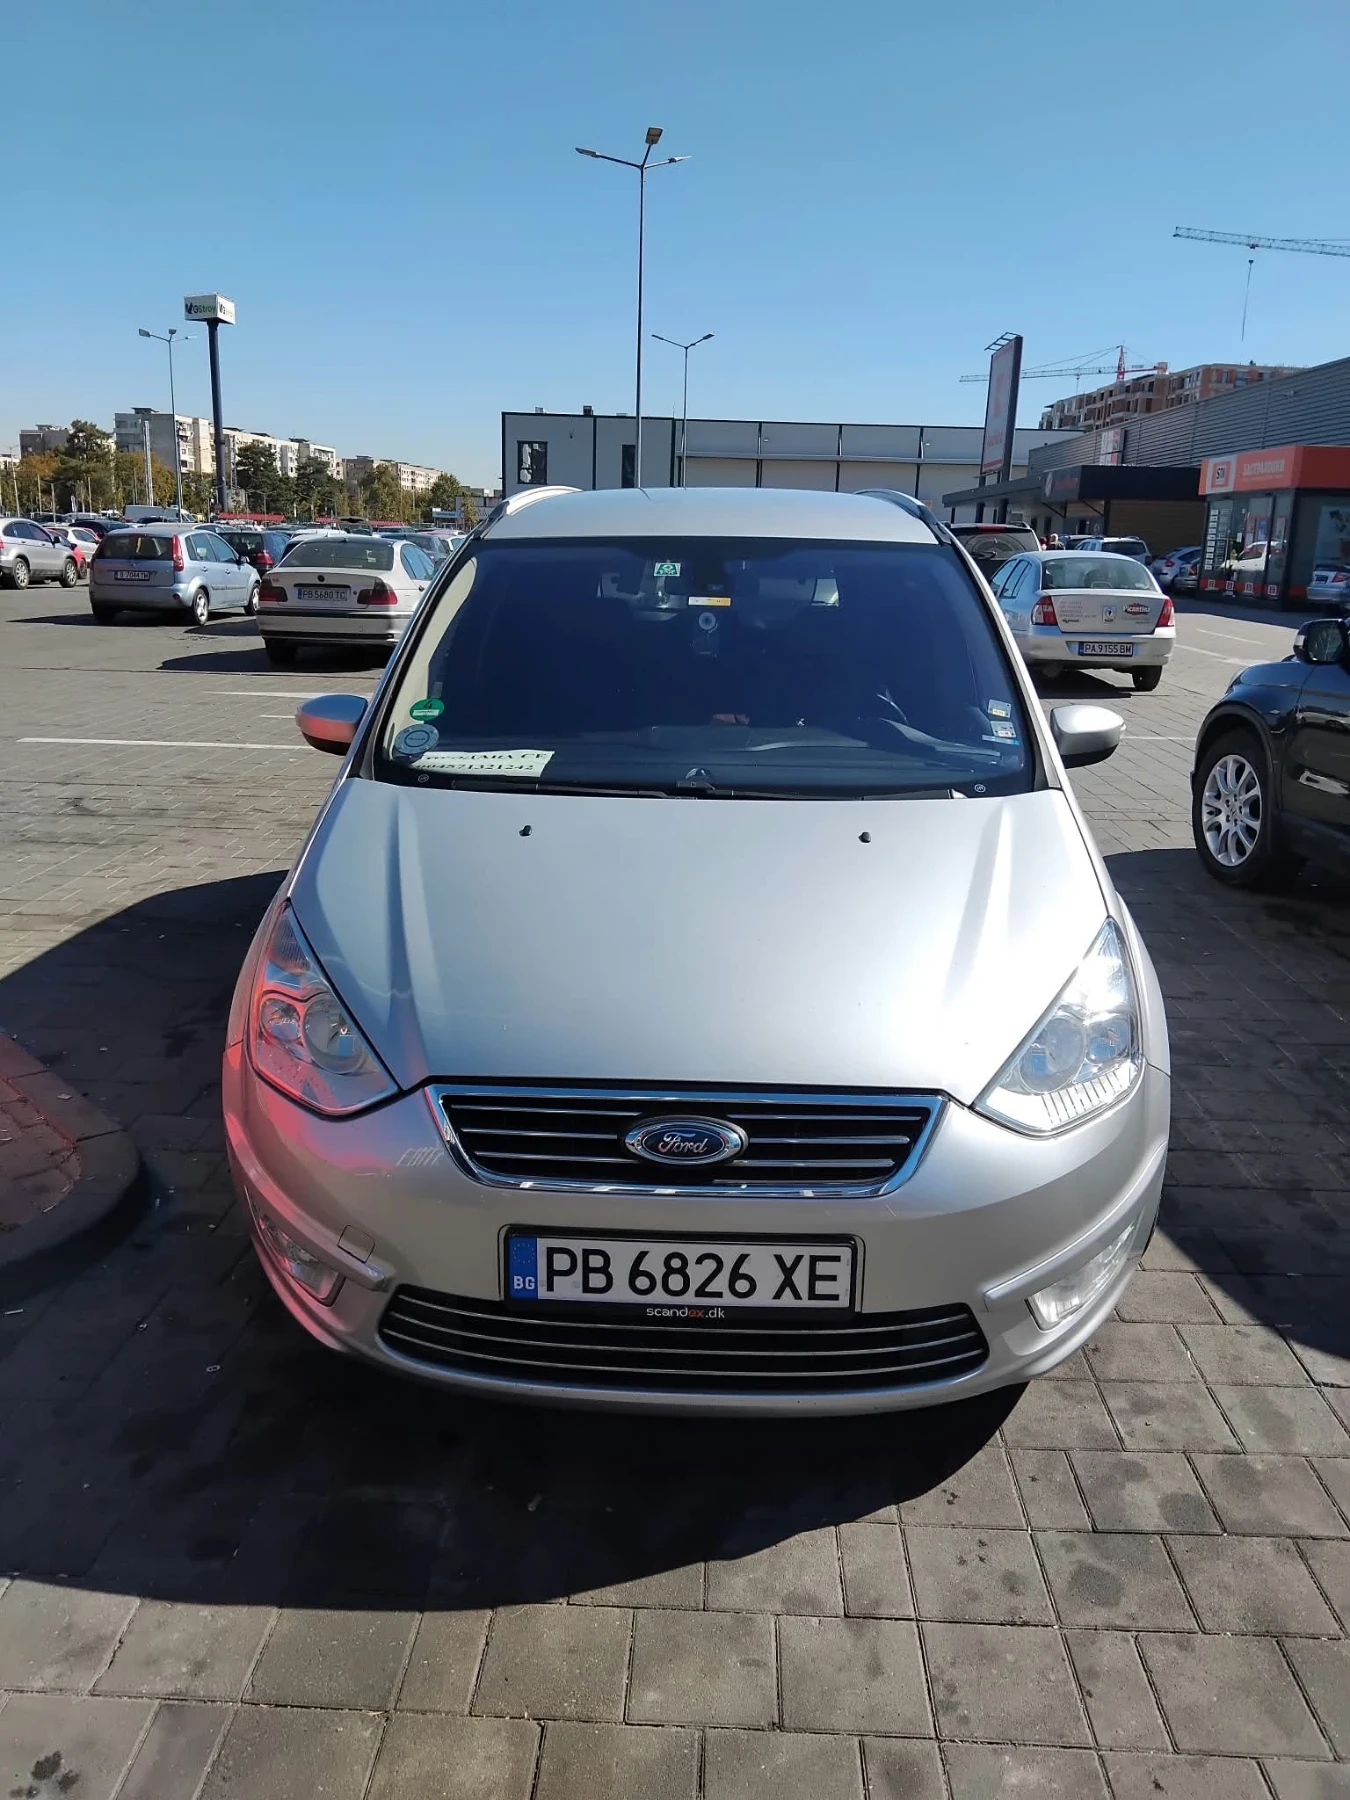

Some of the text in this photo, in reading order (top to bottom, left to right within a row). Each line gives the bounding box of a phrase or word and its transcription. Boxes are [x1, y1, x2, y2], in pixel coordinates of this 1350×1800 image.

[1084, 644, 1096, 653] PA
[1097, 644, 1119, 653] 9155
[424, 699, 433, 710] 4
[658, 1132, 708, 1153] Ford
[546, 1246, 842, 1302] PB 6826 XE
[513, 1275, 536, 1291] BG
[646, 1306, 725, 1319] scandex.dk
